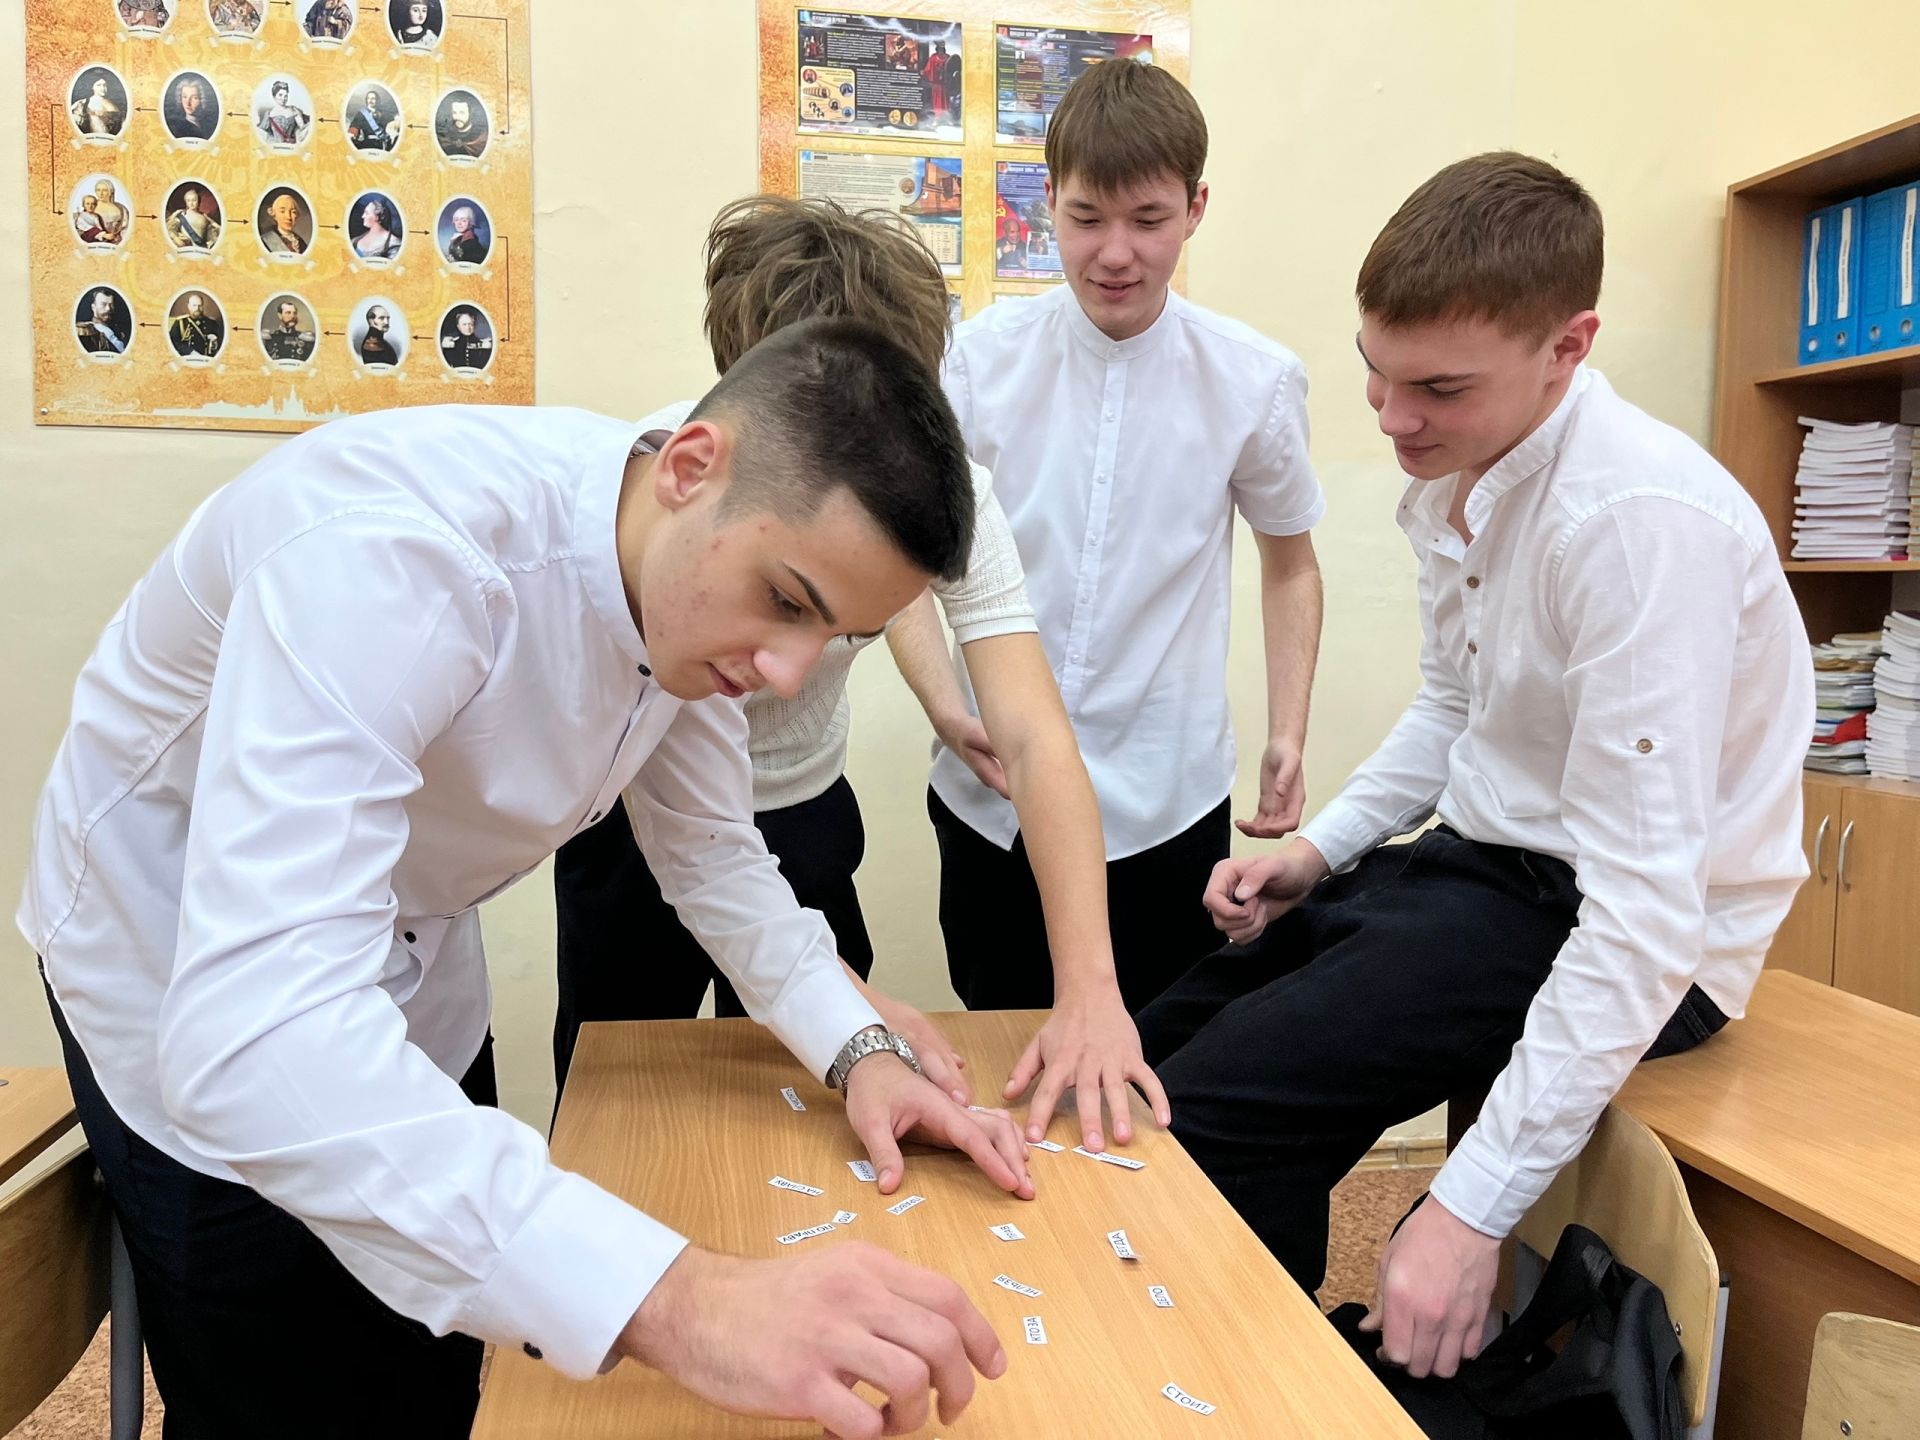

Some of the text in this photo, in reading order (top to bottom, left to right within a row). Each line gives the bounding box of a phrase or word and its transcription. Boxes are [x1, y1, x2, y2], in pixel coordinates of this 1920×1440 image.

[816, 1224, 833, 1233] ПО
[1112, 1232, 1131, 1257] СЕГДА
[997, 1275, 1039, 1296] НЕЛЬЗЯ
[1027, 1317, 1041, 1342] КТО ЗА
